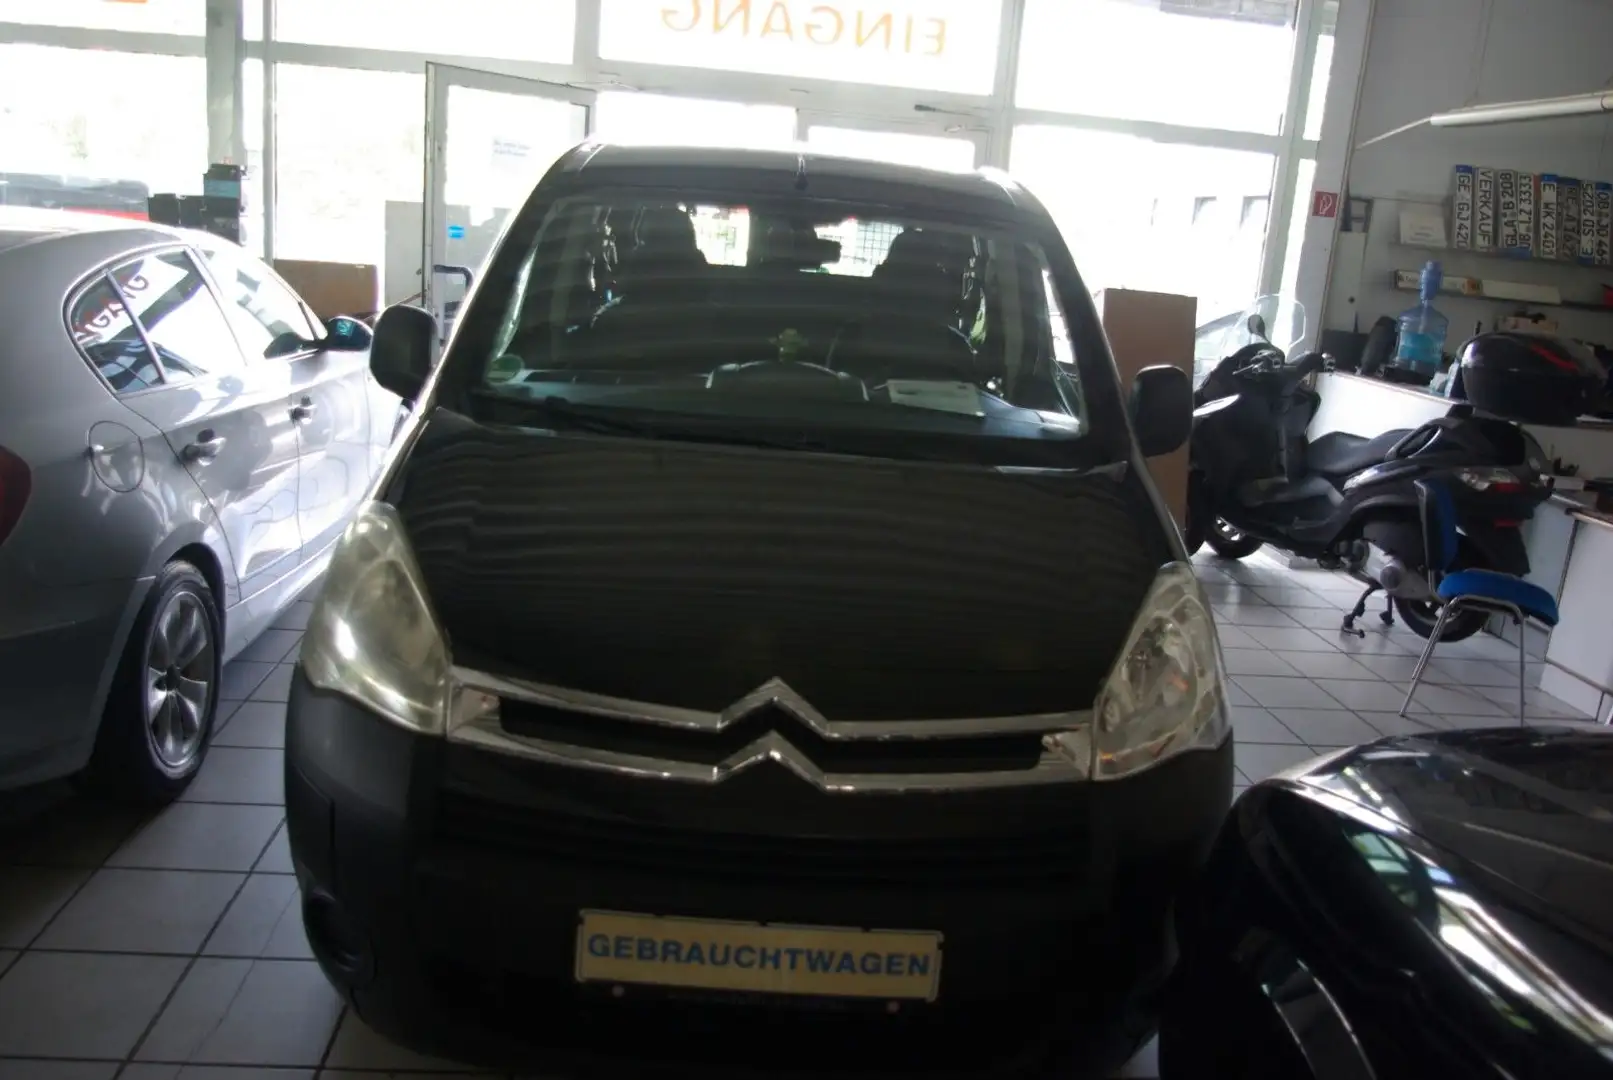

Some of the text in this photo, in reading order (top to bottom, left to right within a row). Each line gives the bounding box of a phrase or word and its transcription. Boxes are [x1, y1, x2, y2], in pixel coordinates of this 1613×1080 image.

[1500, 172, 1514, 198] 208
[1519, 175, 1532, 205] 3333
[588, 934, 930, 976] GEBRAUCHTWAGEN
